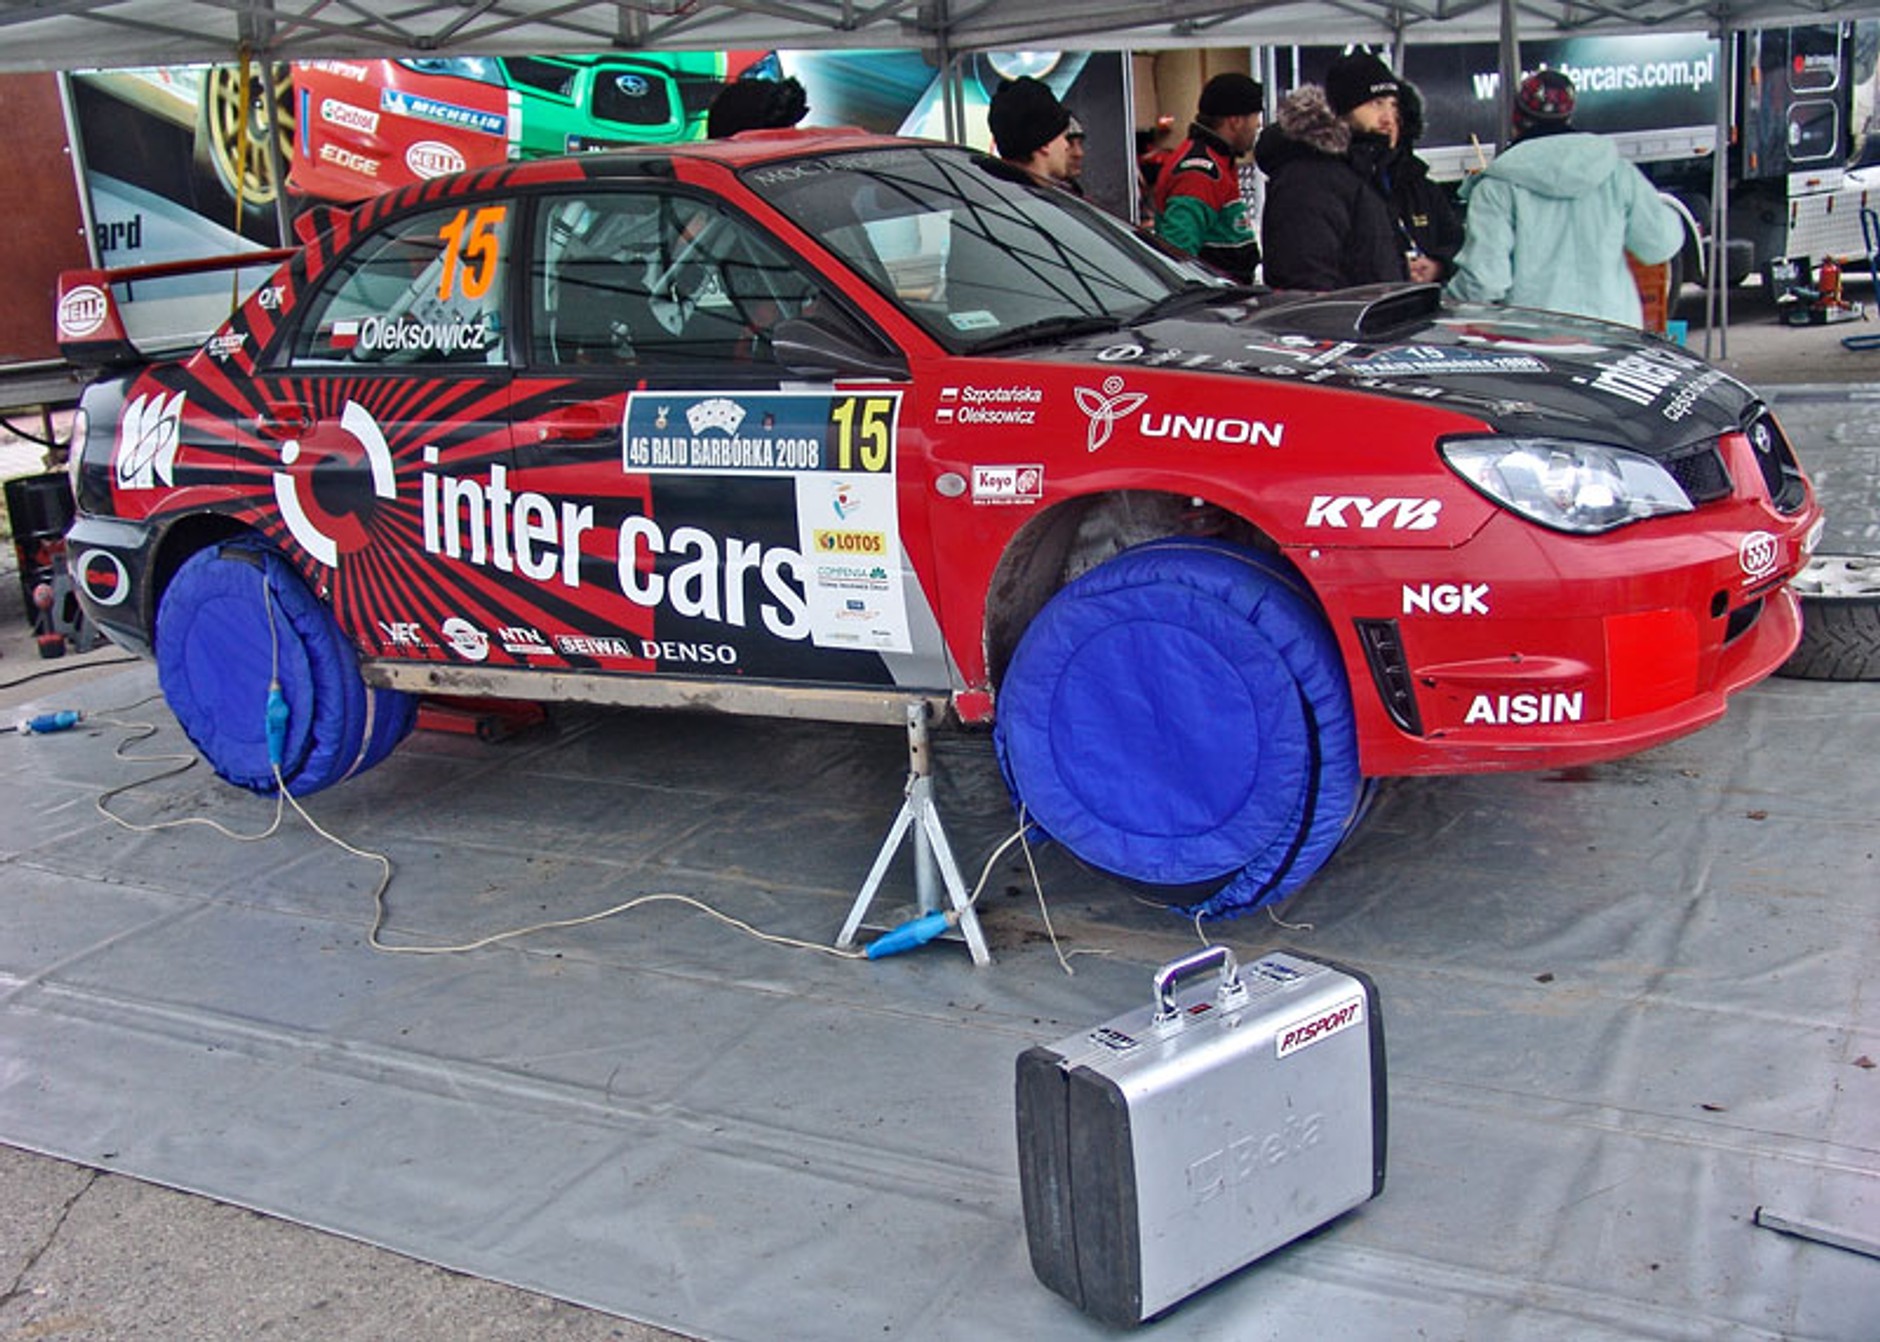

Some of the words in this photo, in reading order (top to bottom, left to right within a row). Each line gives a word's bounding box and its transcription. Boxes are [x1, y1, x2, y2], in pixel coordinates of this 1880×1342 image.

[334, 105, 374, 129] Castrol
[411, 101, 501, 129] MICHELIN
[320, 143, 380, 176] EDGE
[98, 214, 141, 250] ard
[438, 206, 507, 301] 15
[361, 317, 485, 350] Oleksowicz
[962, 385, 1042, 405] Szpotańska
[958, 406, 1036, 424] Oleksowicz
[1139, 413, 1284, 447] UNION
[630, 437, 649, 465] 46
[651, 437, 688, 466] RAJD
[690, 433, 773, 467] BARBÓRKA
[775, 438, 820, 468] 2008
[832, 397, 891, 472] 15
[1304, 495, 1442, 531] KYB
[421, 445, 593, 588] inter
[617, 514, 814, 641] cars
[837, 533, 881, 552] LOTOS
[1746, 542, 1771, 570] 555
[1402, 583, 1489, 615] NGK
[498, 626, 545, 645] NTN
[561, 637, 627, 657] SEIWA
[640, 640, 737, 664] DENSO
[1464, 691, 1584, 724] AISIN
